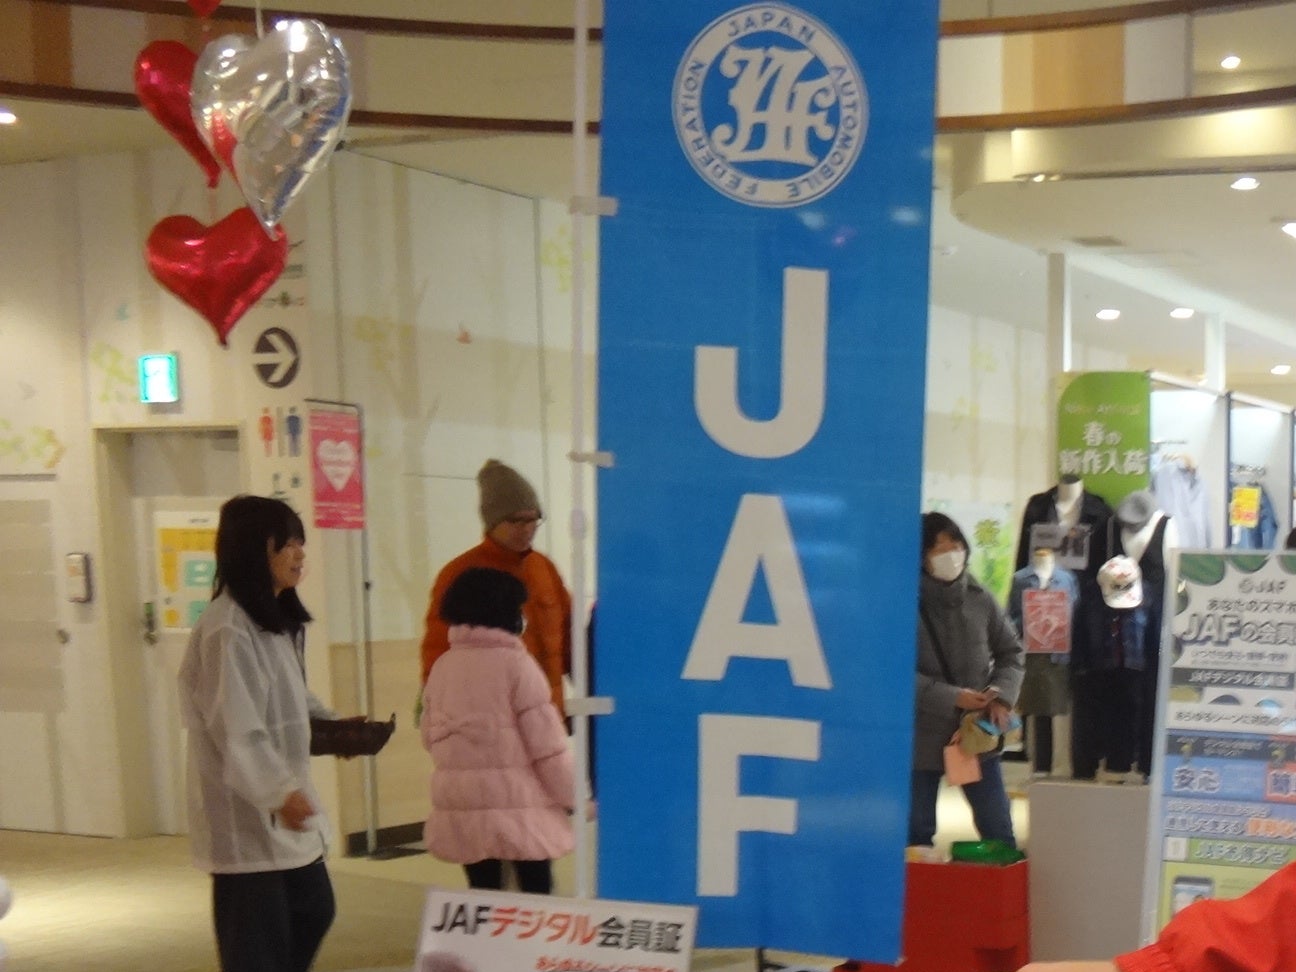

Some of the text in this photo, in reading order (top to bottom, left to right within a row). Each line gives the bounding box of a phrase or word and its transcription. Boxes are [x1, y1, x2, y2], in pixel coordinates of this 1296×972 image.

[727, 11, 816, 43] JAPAN
[681, 59, 759, 196] FEDERATION
[785, 64, 858, 199] AUTOMOBILE
[680, 266, 833, 897] JAF
[431, 902, 686, 954] JAFデジタル会員証
